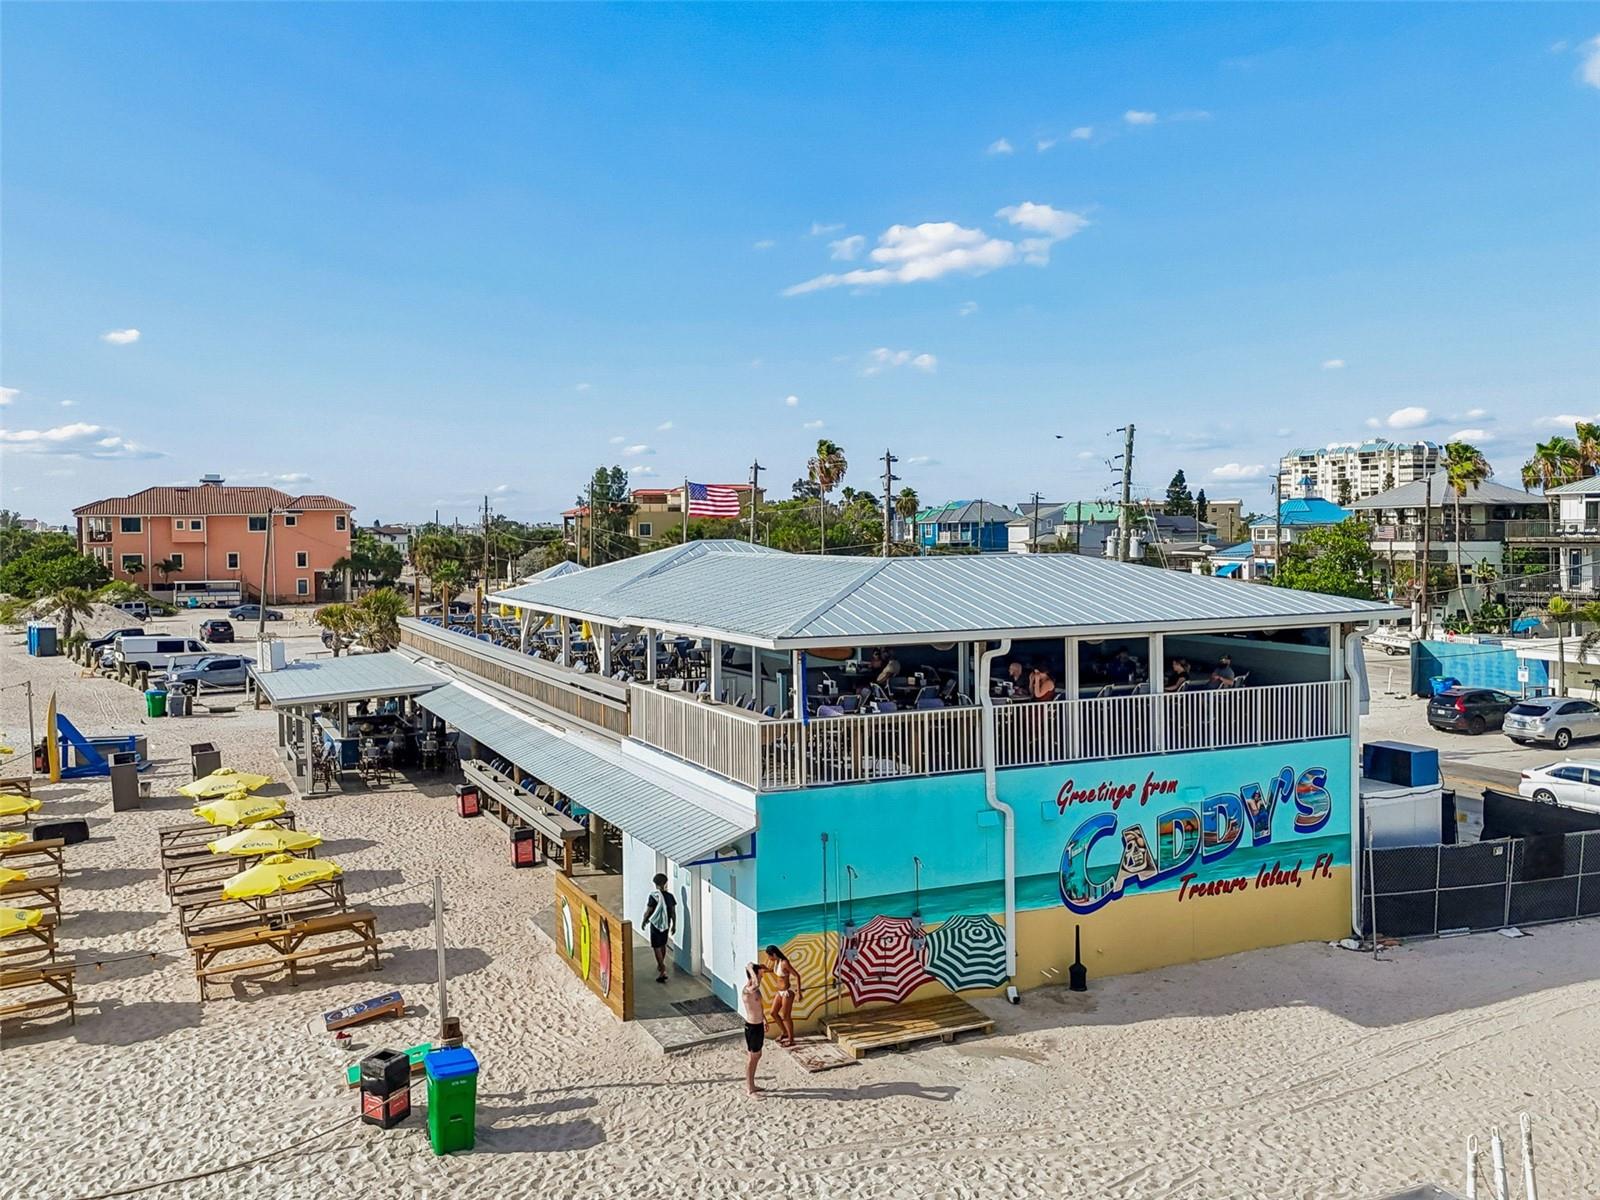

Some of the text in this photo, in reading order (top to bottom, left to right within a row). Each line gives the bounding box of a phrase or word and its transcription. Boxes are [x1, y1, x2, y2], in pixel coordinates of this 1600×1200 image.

[1057, 771, 1178, 815] Greetings from
[1059, 766, 1332, 914] CADDY'S
[1178, 852, 1334, 902] Treasure Island, Fl.
